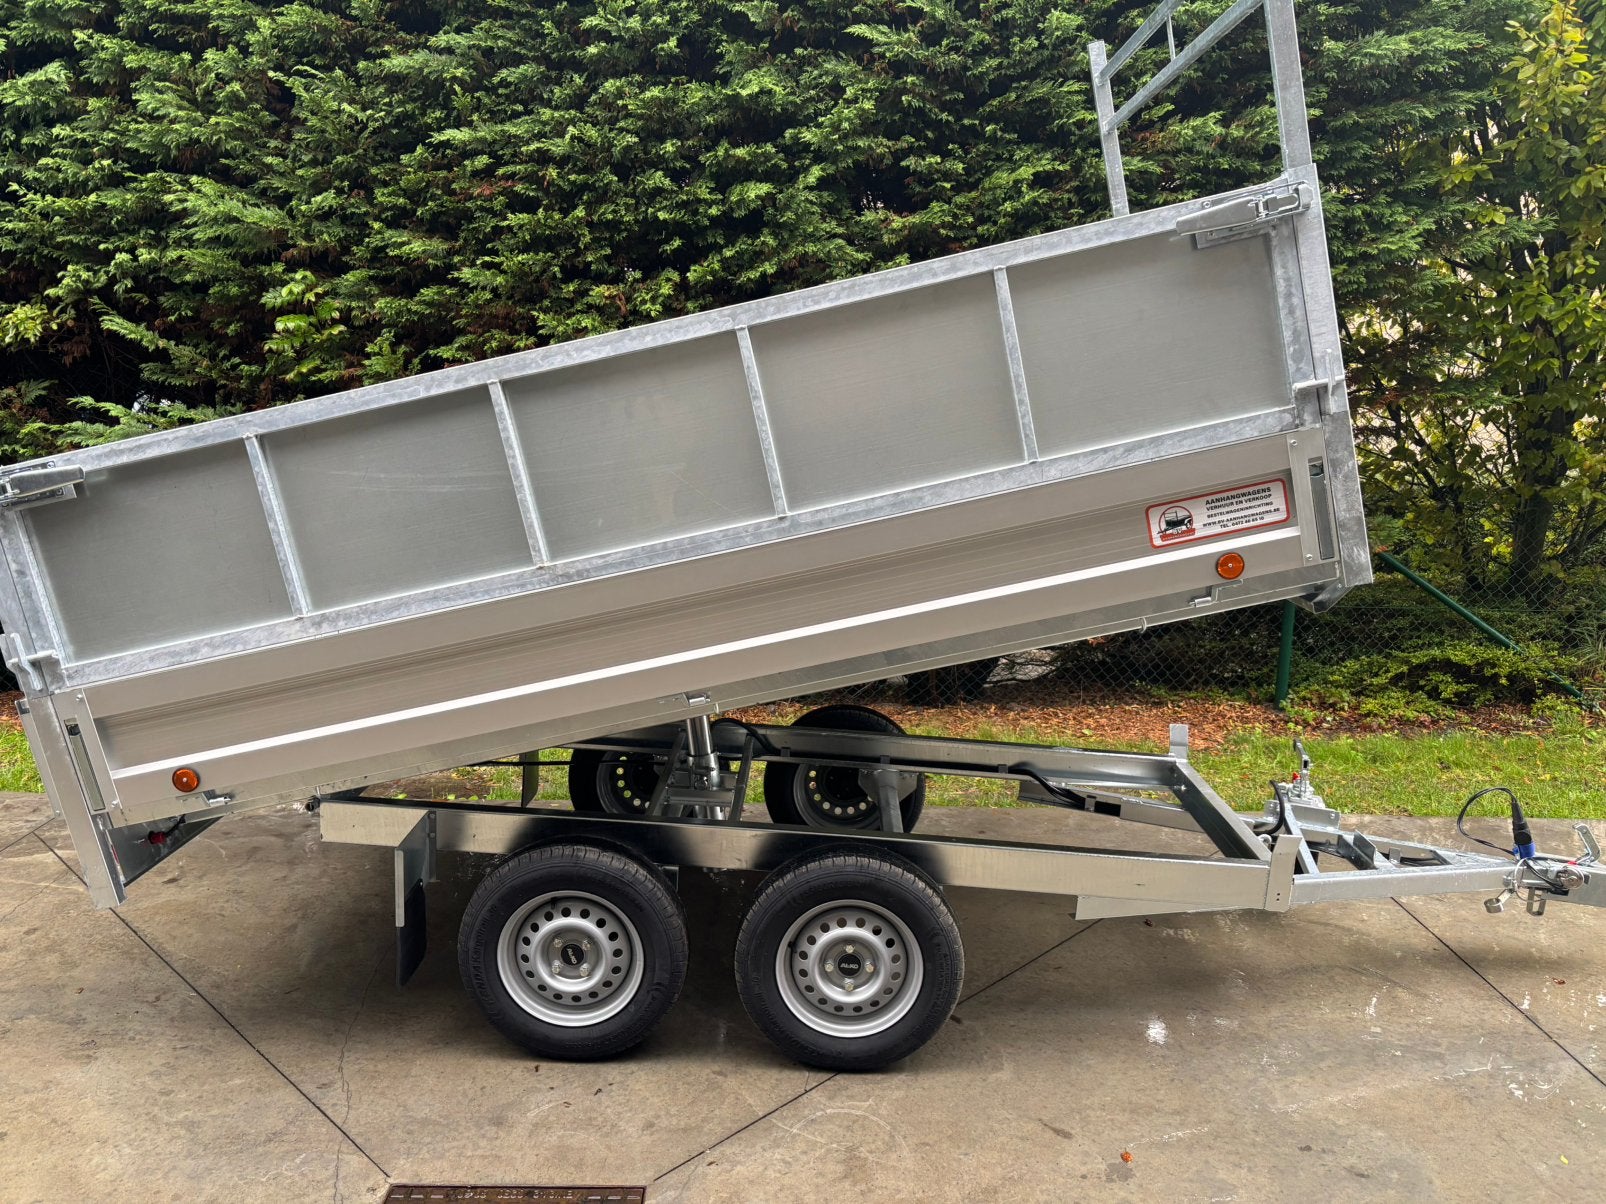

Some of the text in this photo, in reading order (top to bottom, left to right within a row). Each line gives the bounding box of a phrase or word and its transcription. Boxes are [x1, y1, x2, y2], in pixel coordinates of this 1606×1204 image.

[1205, 486, 1272, 505] AANHANGWAGENS
[1206, 501, 1235, 511] VERHUUR
[1244, 493, 1272, 503] VERKOOP
